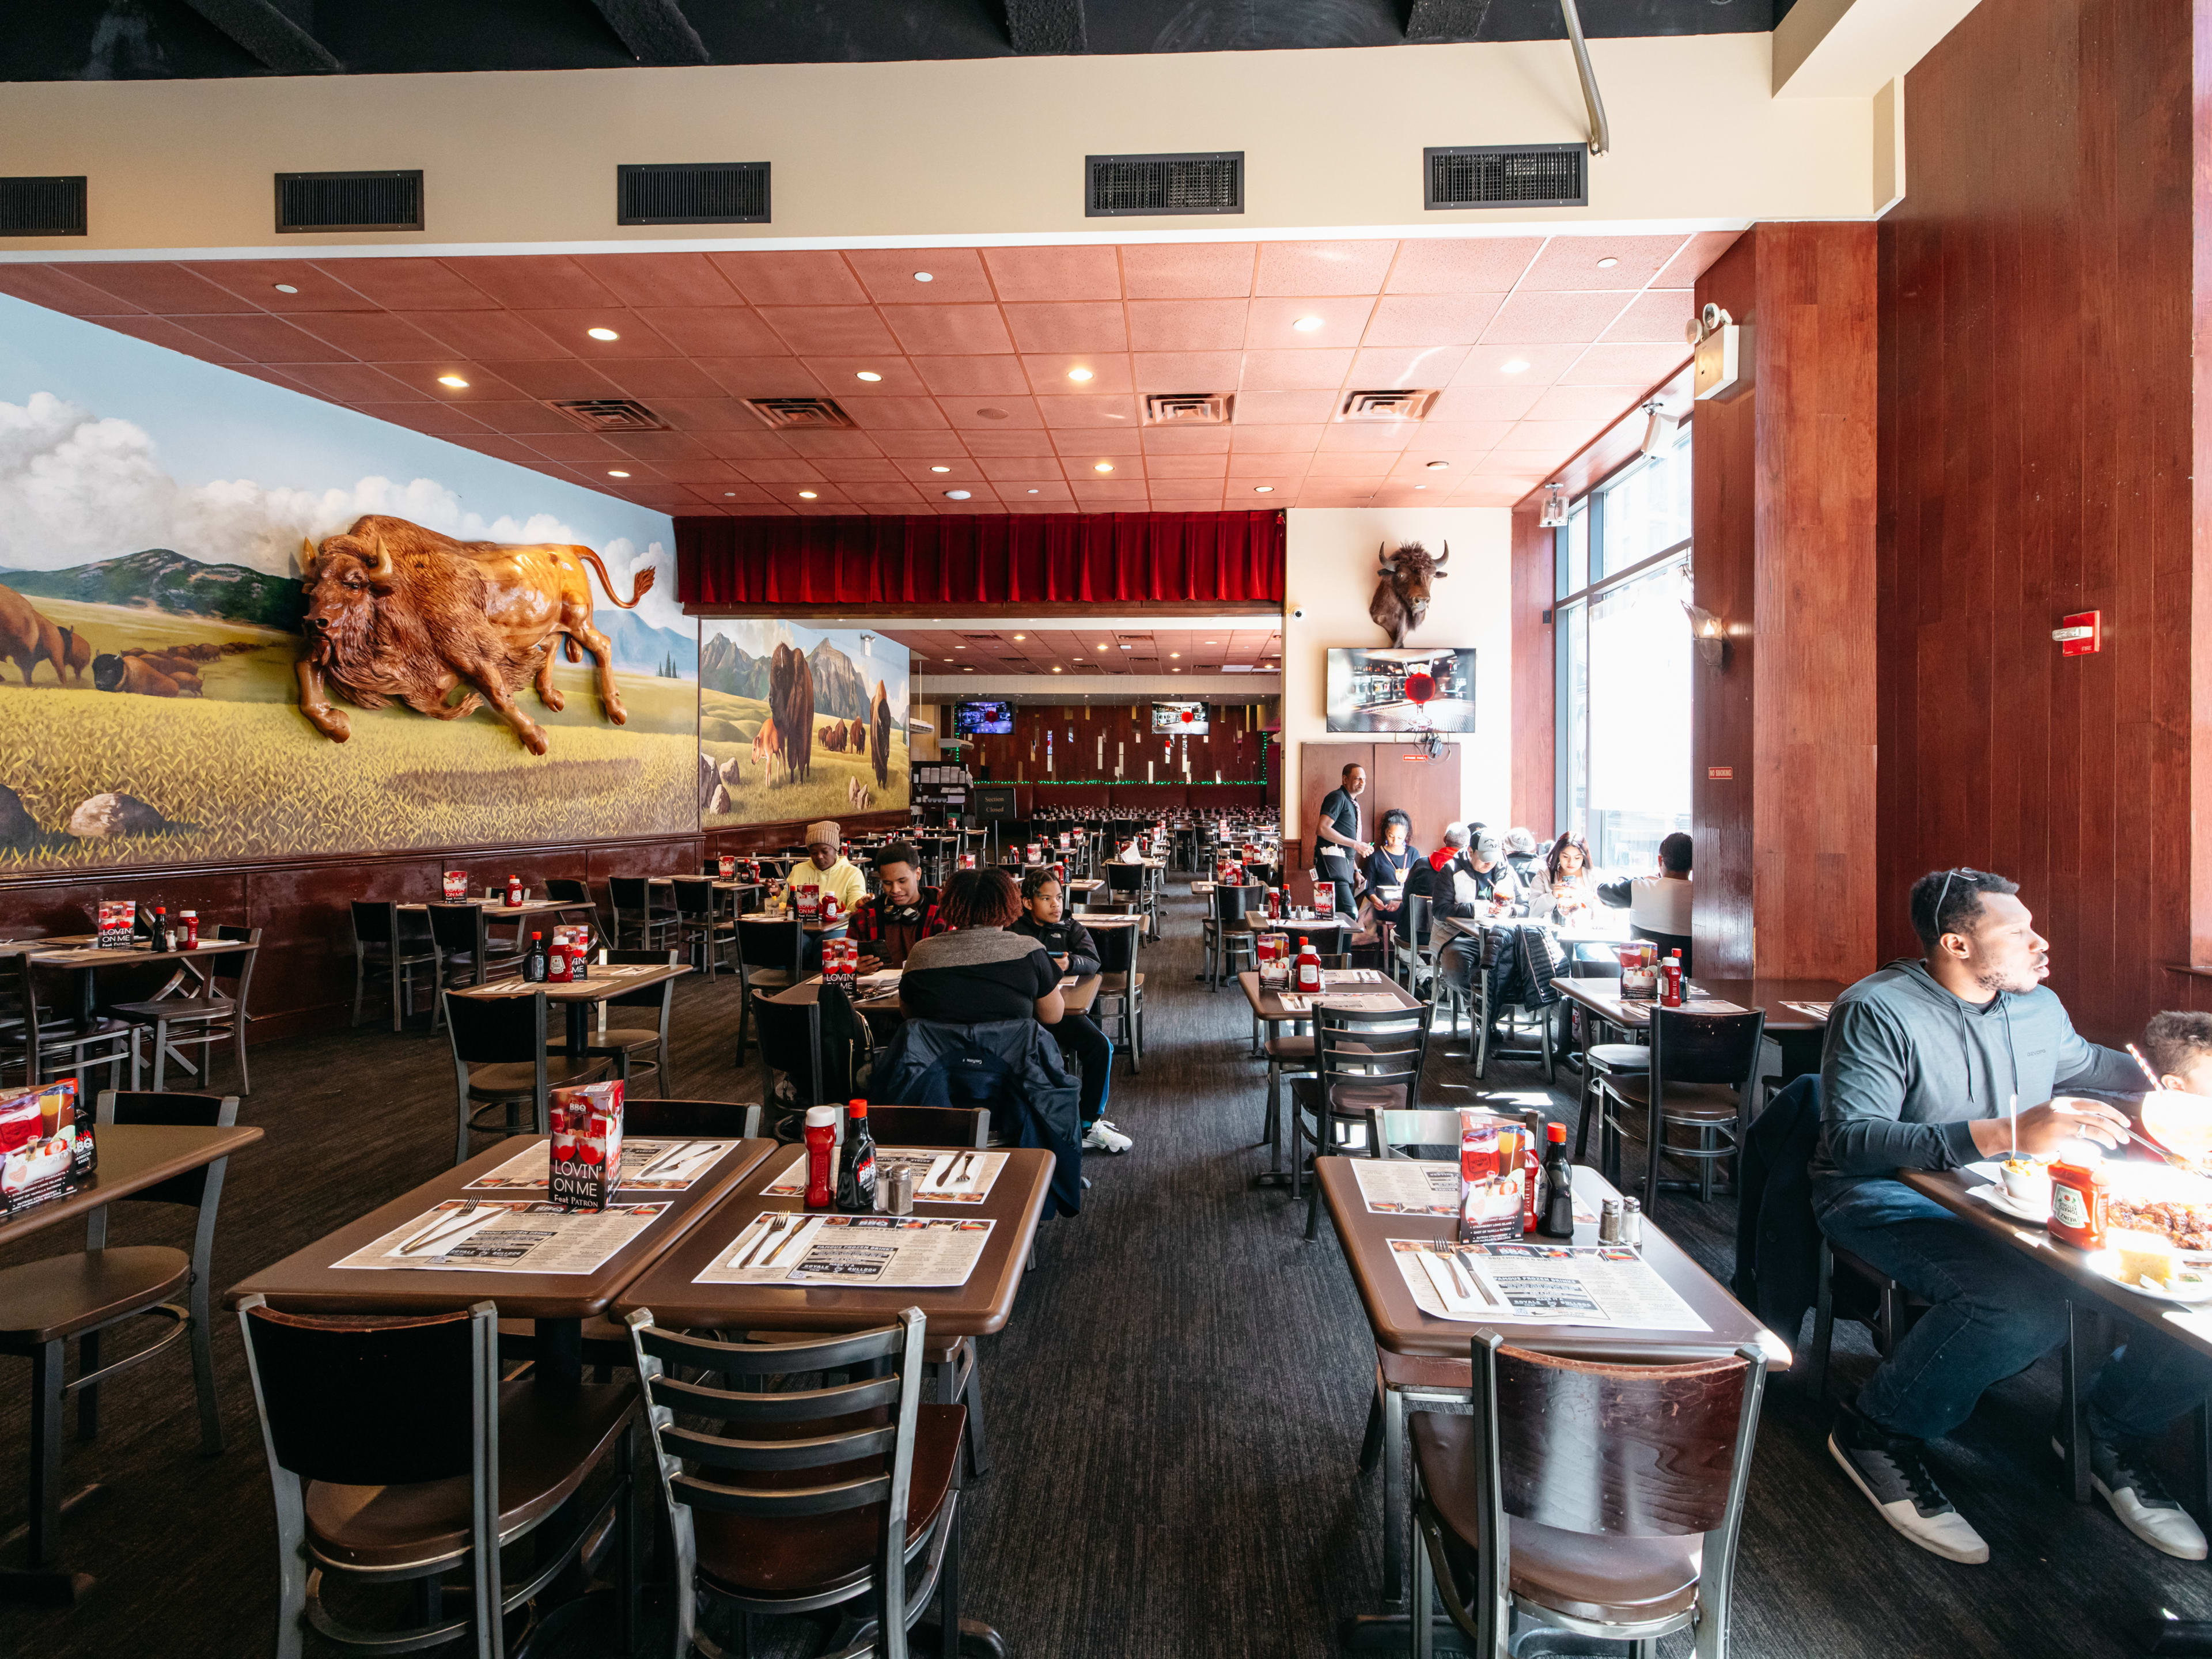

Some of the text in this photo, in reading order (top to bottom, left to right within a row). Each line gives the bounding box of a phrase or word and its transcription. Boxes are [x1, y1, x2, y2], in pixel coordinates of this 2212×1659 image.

[103, 927, 133, 936] LOVIN'
[571, 965, 584, 973] ME
[826, 973, 855, 982] LOVIN'
[840, 982, 853, 990] ME
[569, 1103, 587, 1112] BBQ
[74, 1137, 93, 1153] BQ
[75, 1151, 92, 1161] ARBECUE
[555, 1160, 602, 1180] LOVIN'
[859, 1163, 876, 1183] BBQ
[554, 1177, 597, 1197] ON ME
[554, 1194, 599, 1208] Feat PATRÓN
[2059, 1205, 2078, 1215] TOMATO
[2060, 1213, 2078, 1223] HEINZ
